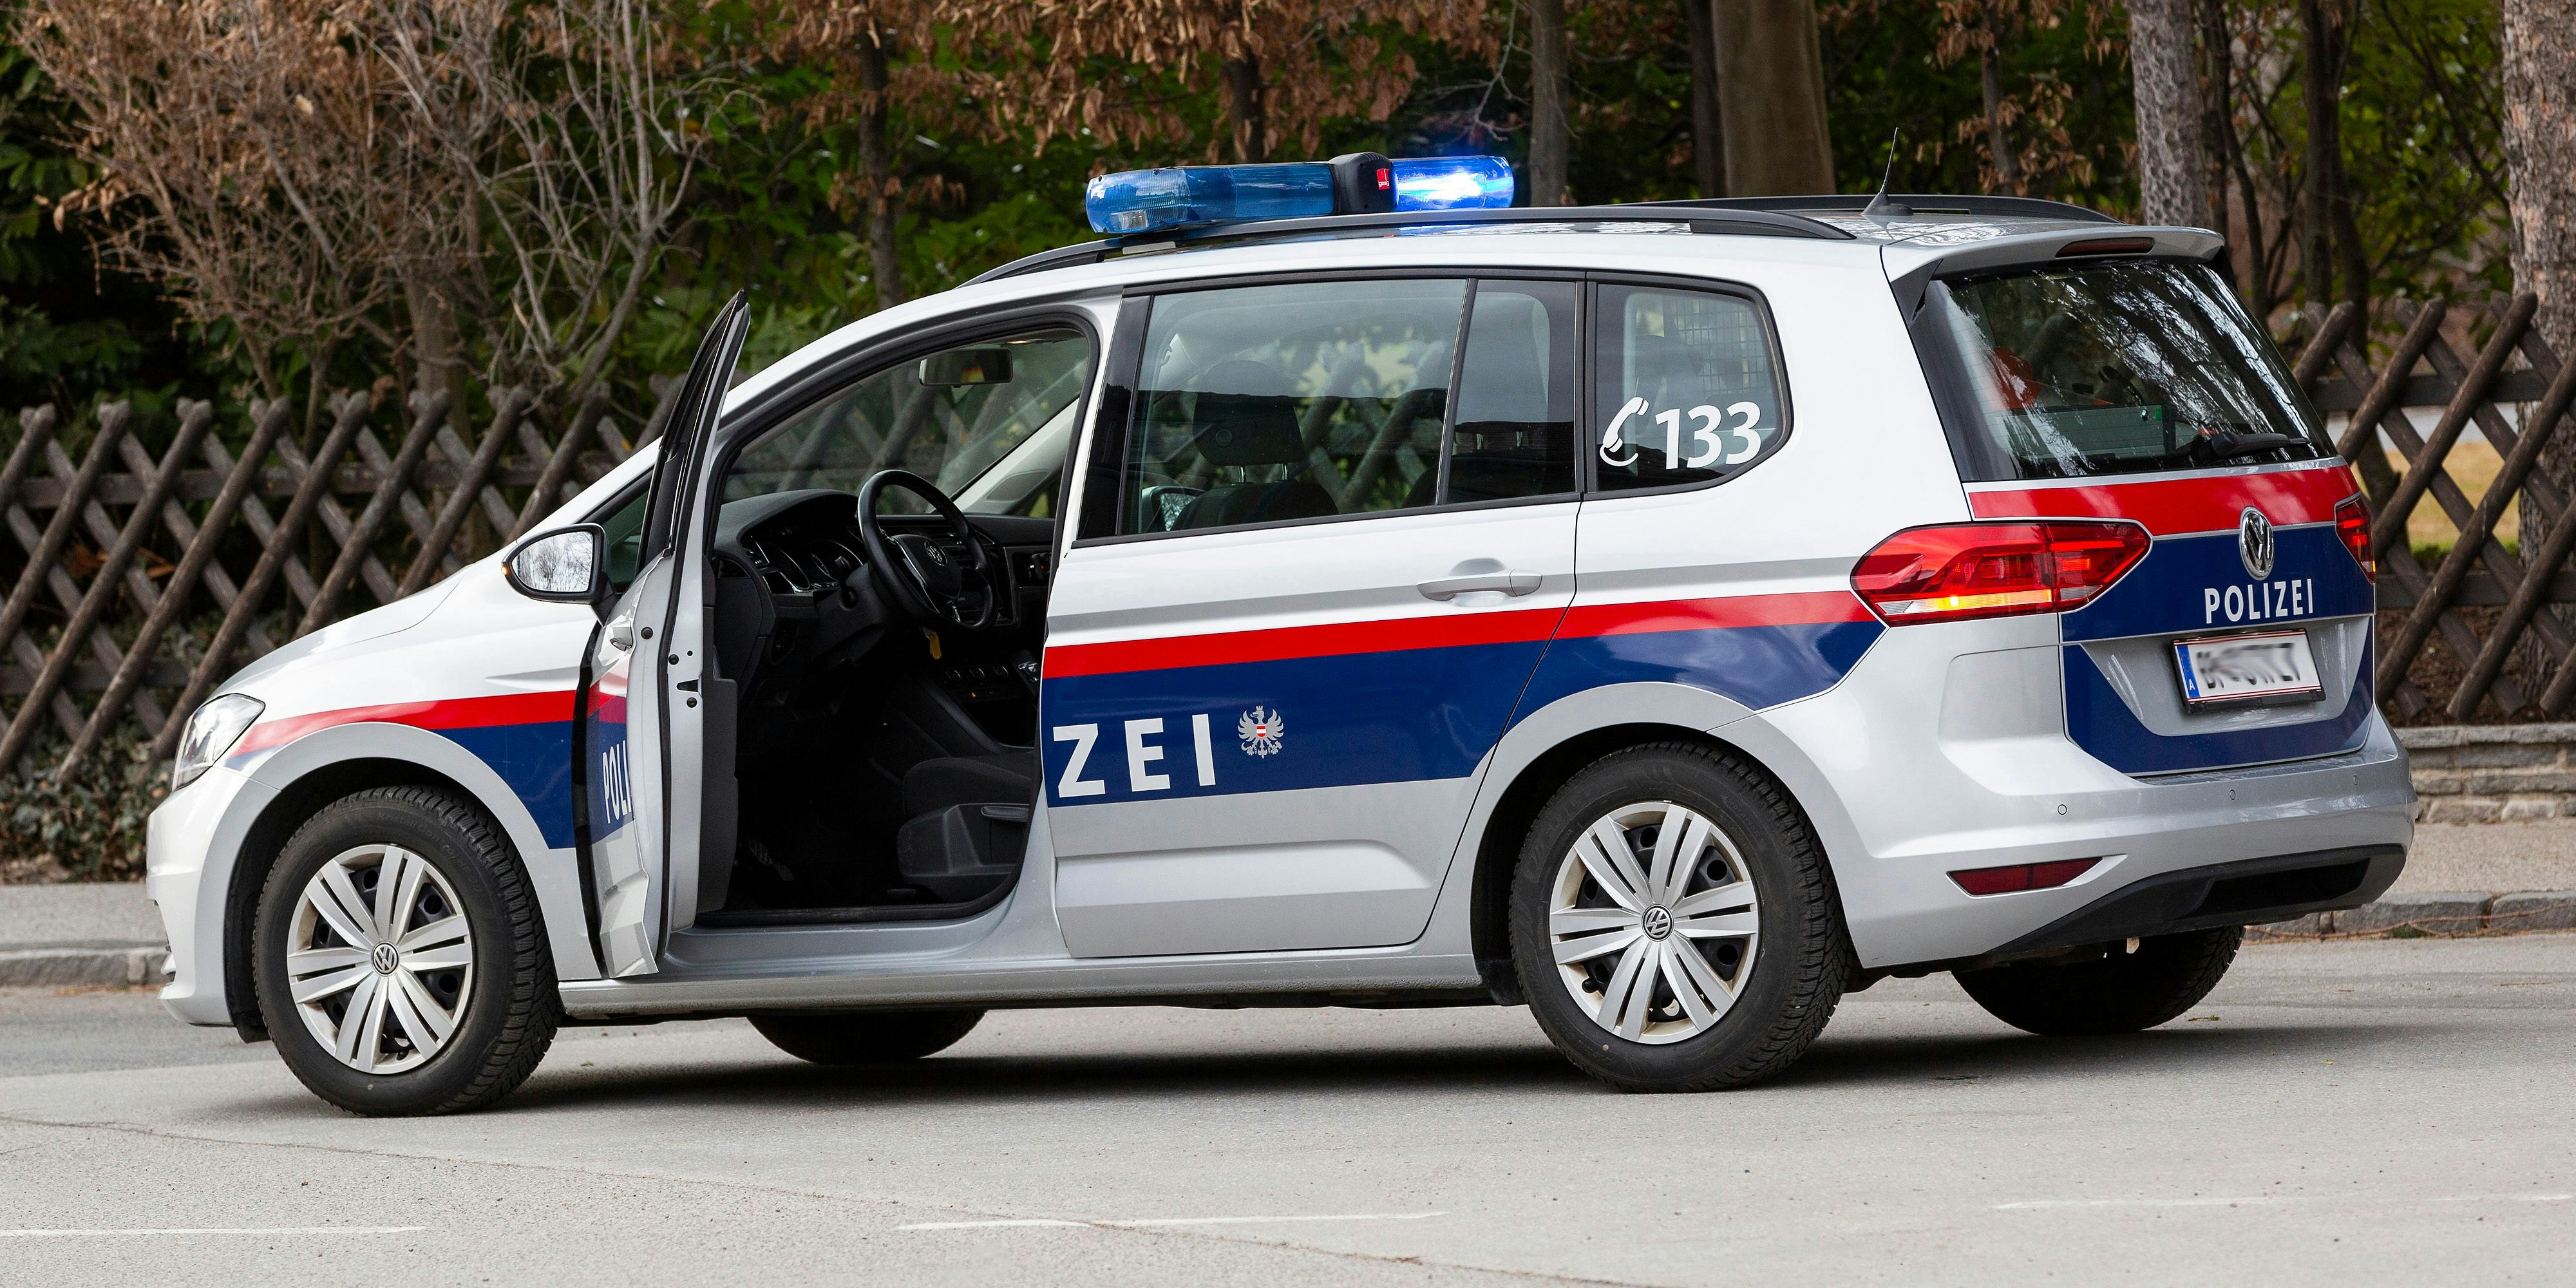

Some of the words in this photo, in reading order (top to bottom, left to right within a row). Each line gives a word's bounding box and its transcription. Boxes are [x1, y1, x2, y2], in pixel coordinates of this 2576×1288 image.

[1655, 401, 1761, 469] 133
[2204, 578, 2314, 623] POLIZEI
[2188, 680, 2195, 690] A
[603, 740, 631, 824] POLI
[1053, 714, 1216, 798] ZEI
